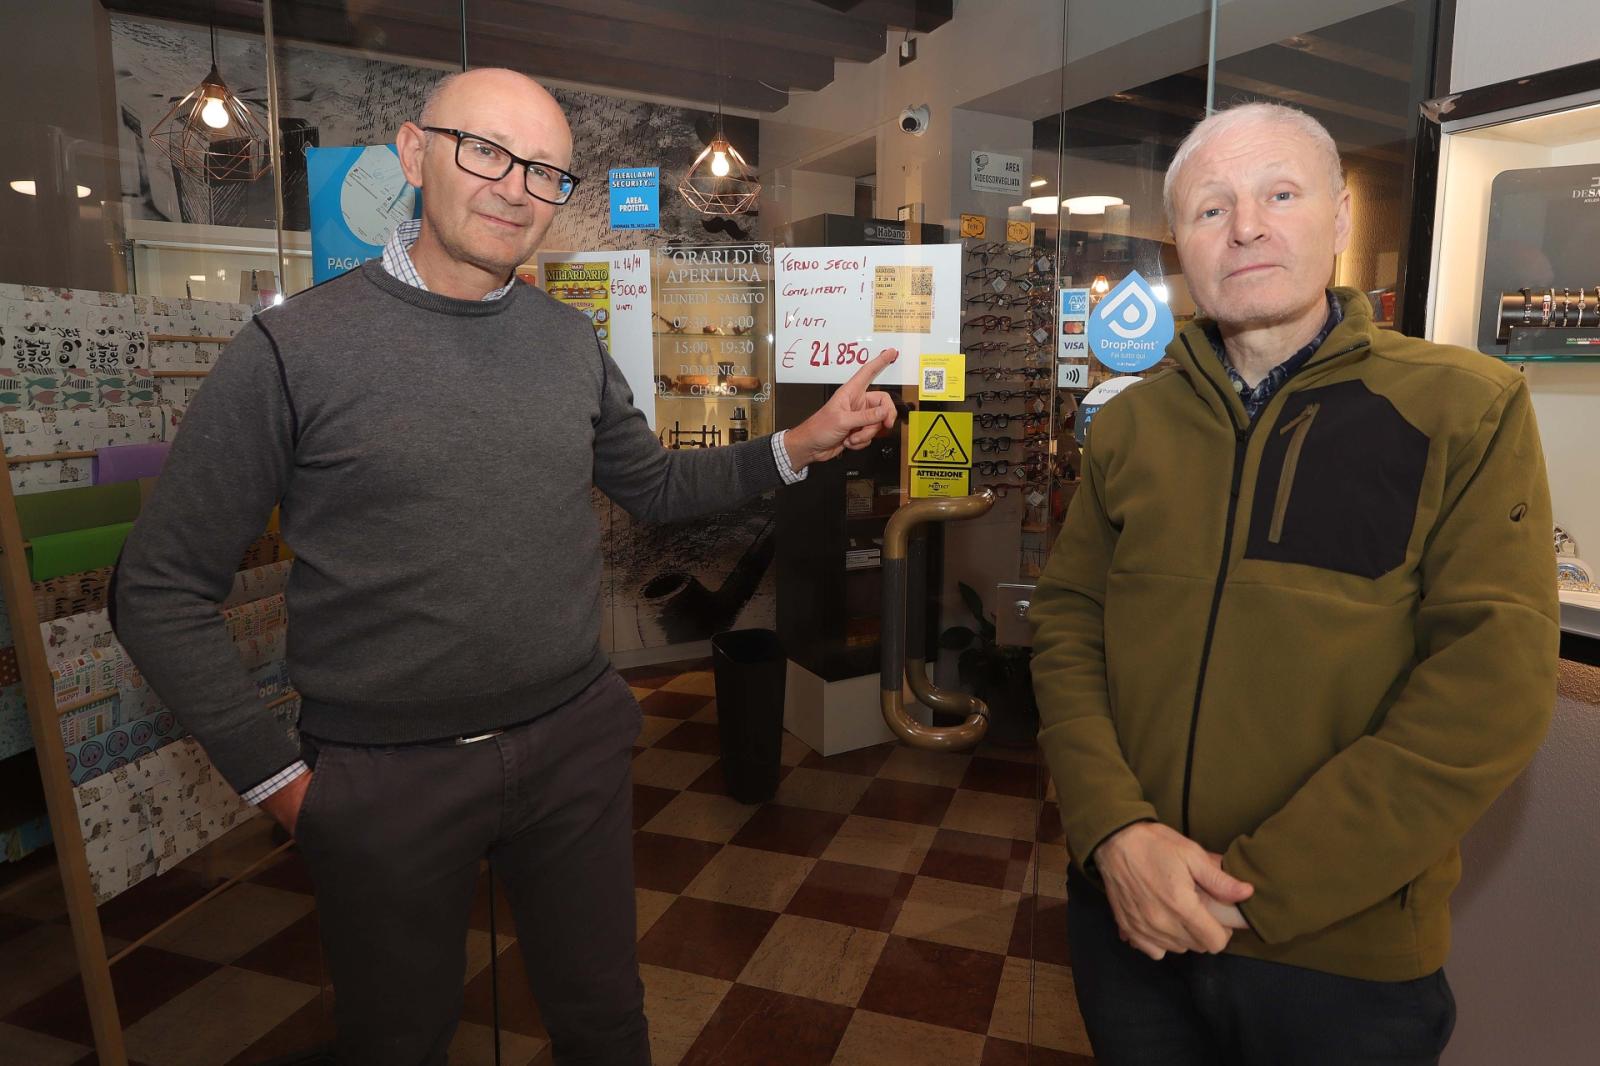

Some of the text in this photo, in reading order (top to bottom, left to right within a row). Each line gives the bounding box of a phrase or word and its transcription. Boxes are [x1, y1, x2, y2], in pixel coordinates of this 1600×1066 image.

[1006, 162, 1020, 173] AREA
[612, 171, 656, 179] TELEALLARMI
[612, 179, 649, 188] SECURITY
[625, 196, 643, 204] AREA
[619, 204, 650, 212] PROTETTA
[877, 226, 911, 240] Habanos
[327, 257, 361, 270] PAGA
[672, 249, 755, 266] ORARI DI
[781, 252, 819, 272] TERNO
[546, 269, 609, 281] MILIARDARIO
[665, 267, 762, 284] APERTURA
[718, 292, 765, 304] SABATO
[784, 307, 827, 329] VINTI
[674, 341, 754, 354] 15:00 19:30
[1064, 342, 1085, 350] VISA
[1101, 339, 1155, 351] DropPoint
[679, 364, 748, 376] DOMENICA
[690, 384, 738, 396] CHIUSO
[916, 469, 964, 478] ATTENZIONE
